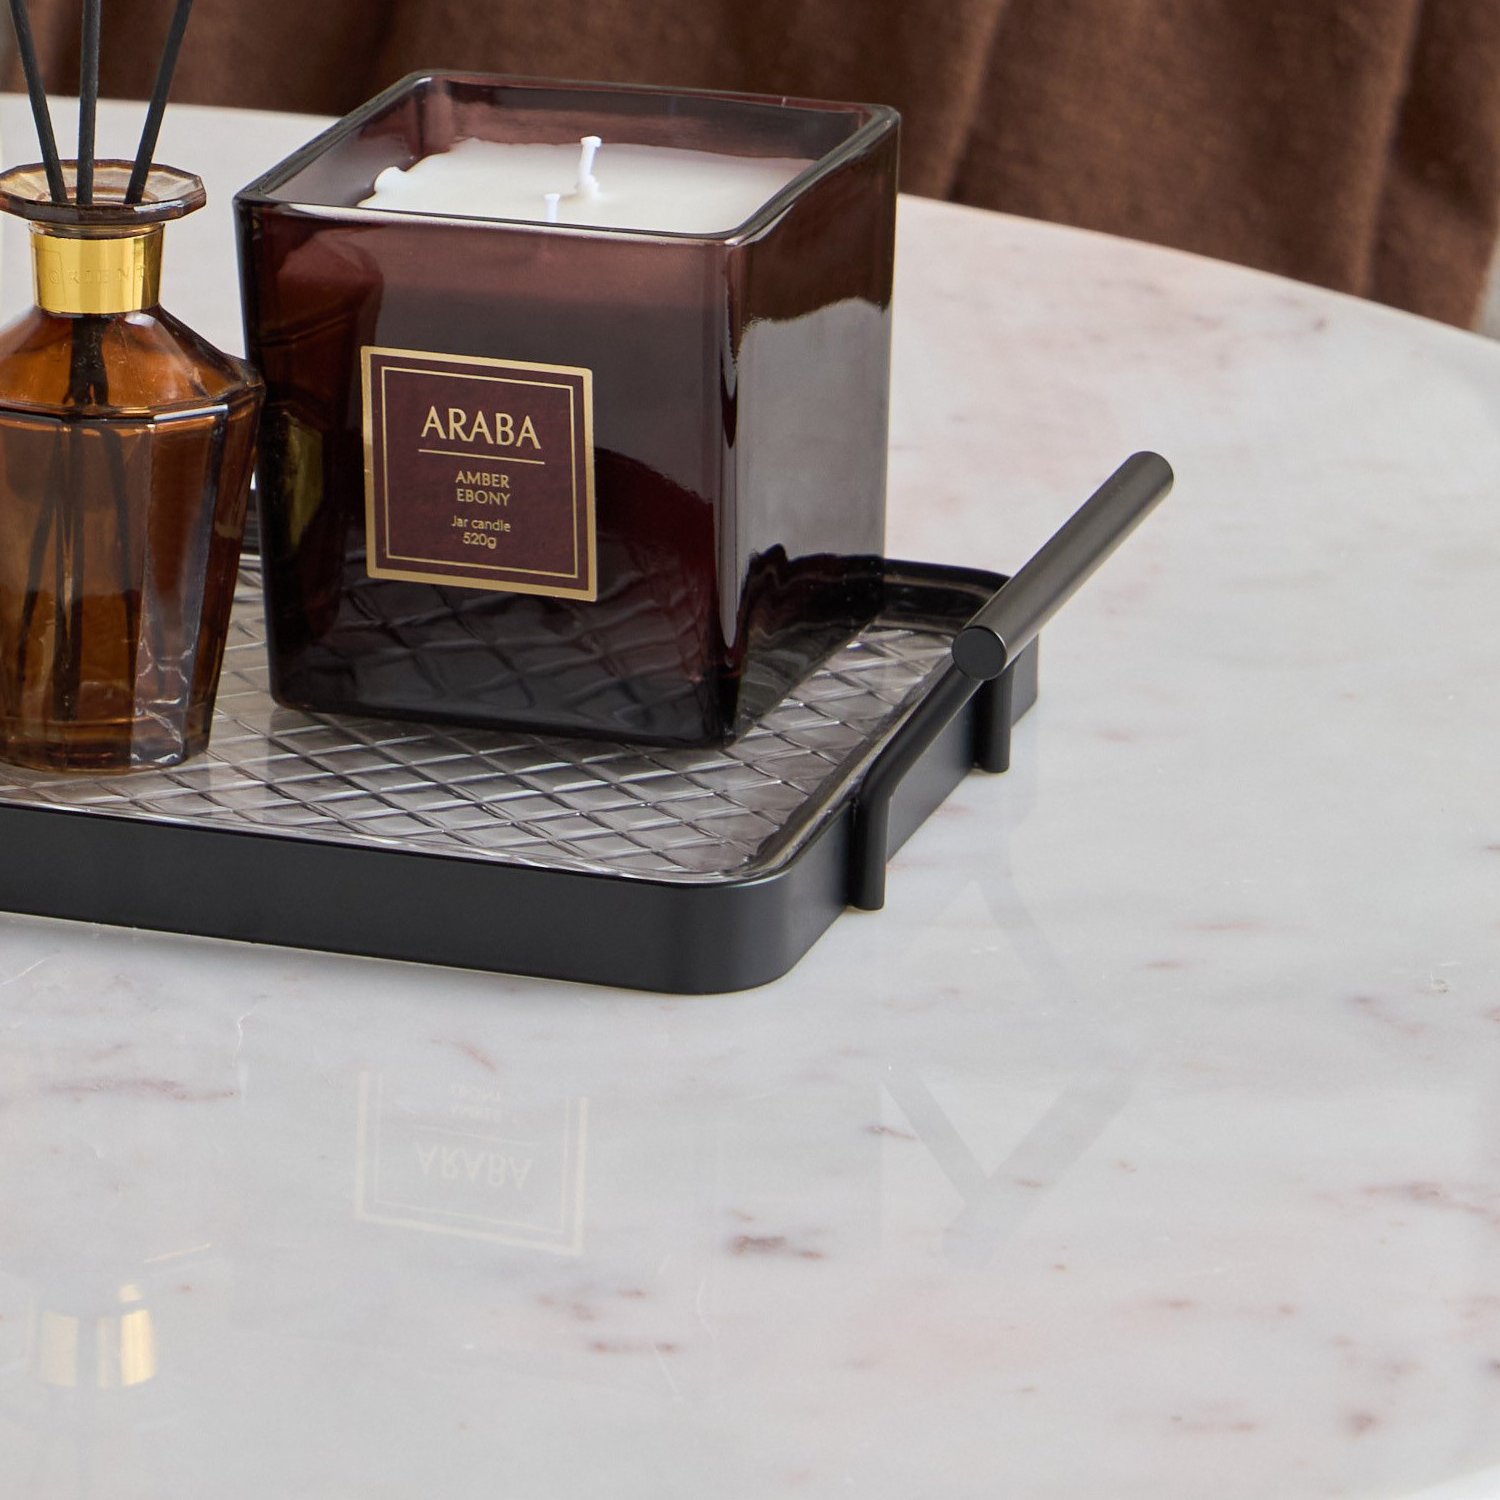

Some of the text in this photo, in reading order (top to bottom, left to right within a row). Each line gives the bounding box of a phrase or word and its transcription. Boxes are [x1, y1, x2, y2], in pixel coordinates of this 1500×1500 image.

[421, 405, 541, 449] ARABA
[455, 470, 510, 489] AMBER
[456, 488, 511, 506] EBONY
[451, 515, 511, 533] Jar candle
[463, 531, 497, 549] 520g
